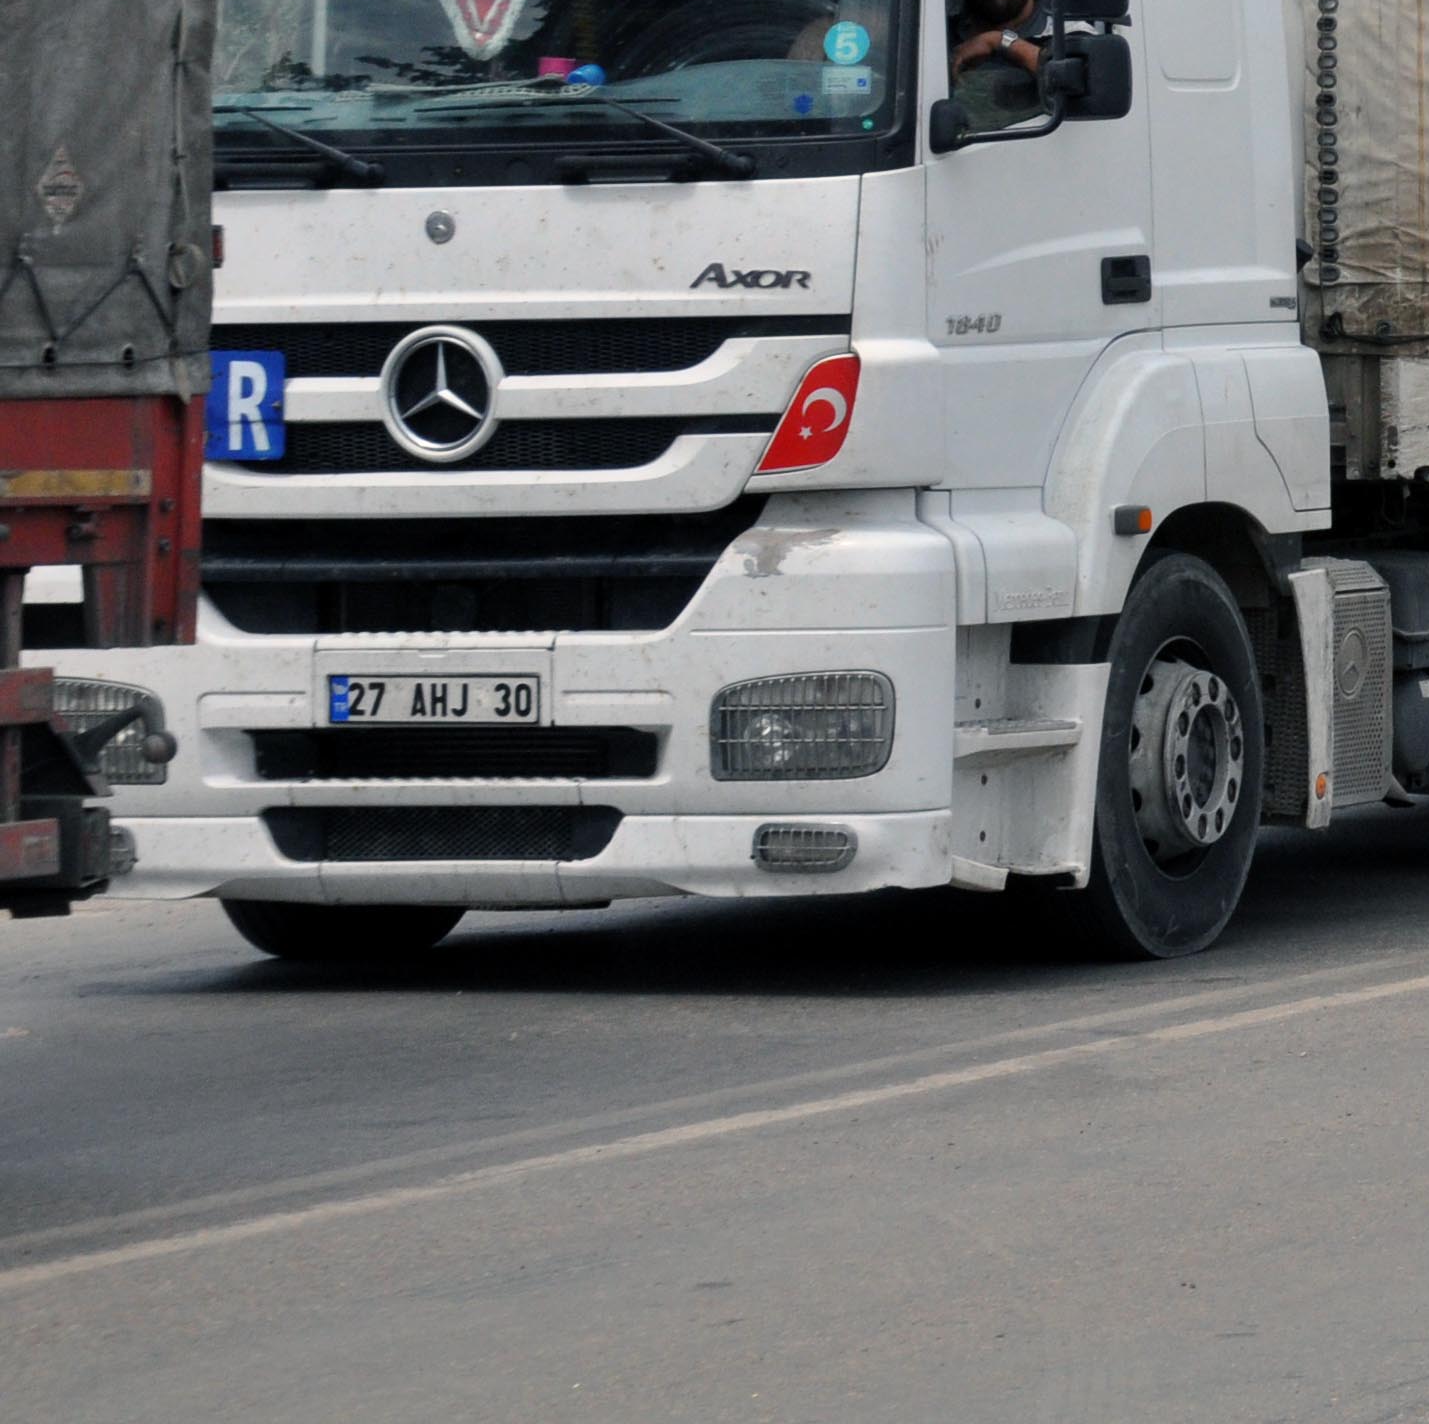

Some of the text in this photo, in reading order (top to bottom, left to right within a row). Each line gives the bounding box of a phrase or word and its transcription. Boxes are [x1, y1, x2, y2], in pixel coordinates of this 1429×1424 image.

[835, 32, 859, 60] 5
[228, 360, 271, 451] R
[349, 682, 532, 717] 27 AHJ 30
